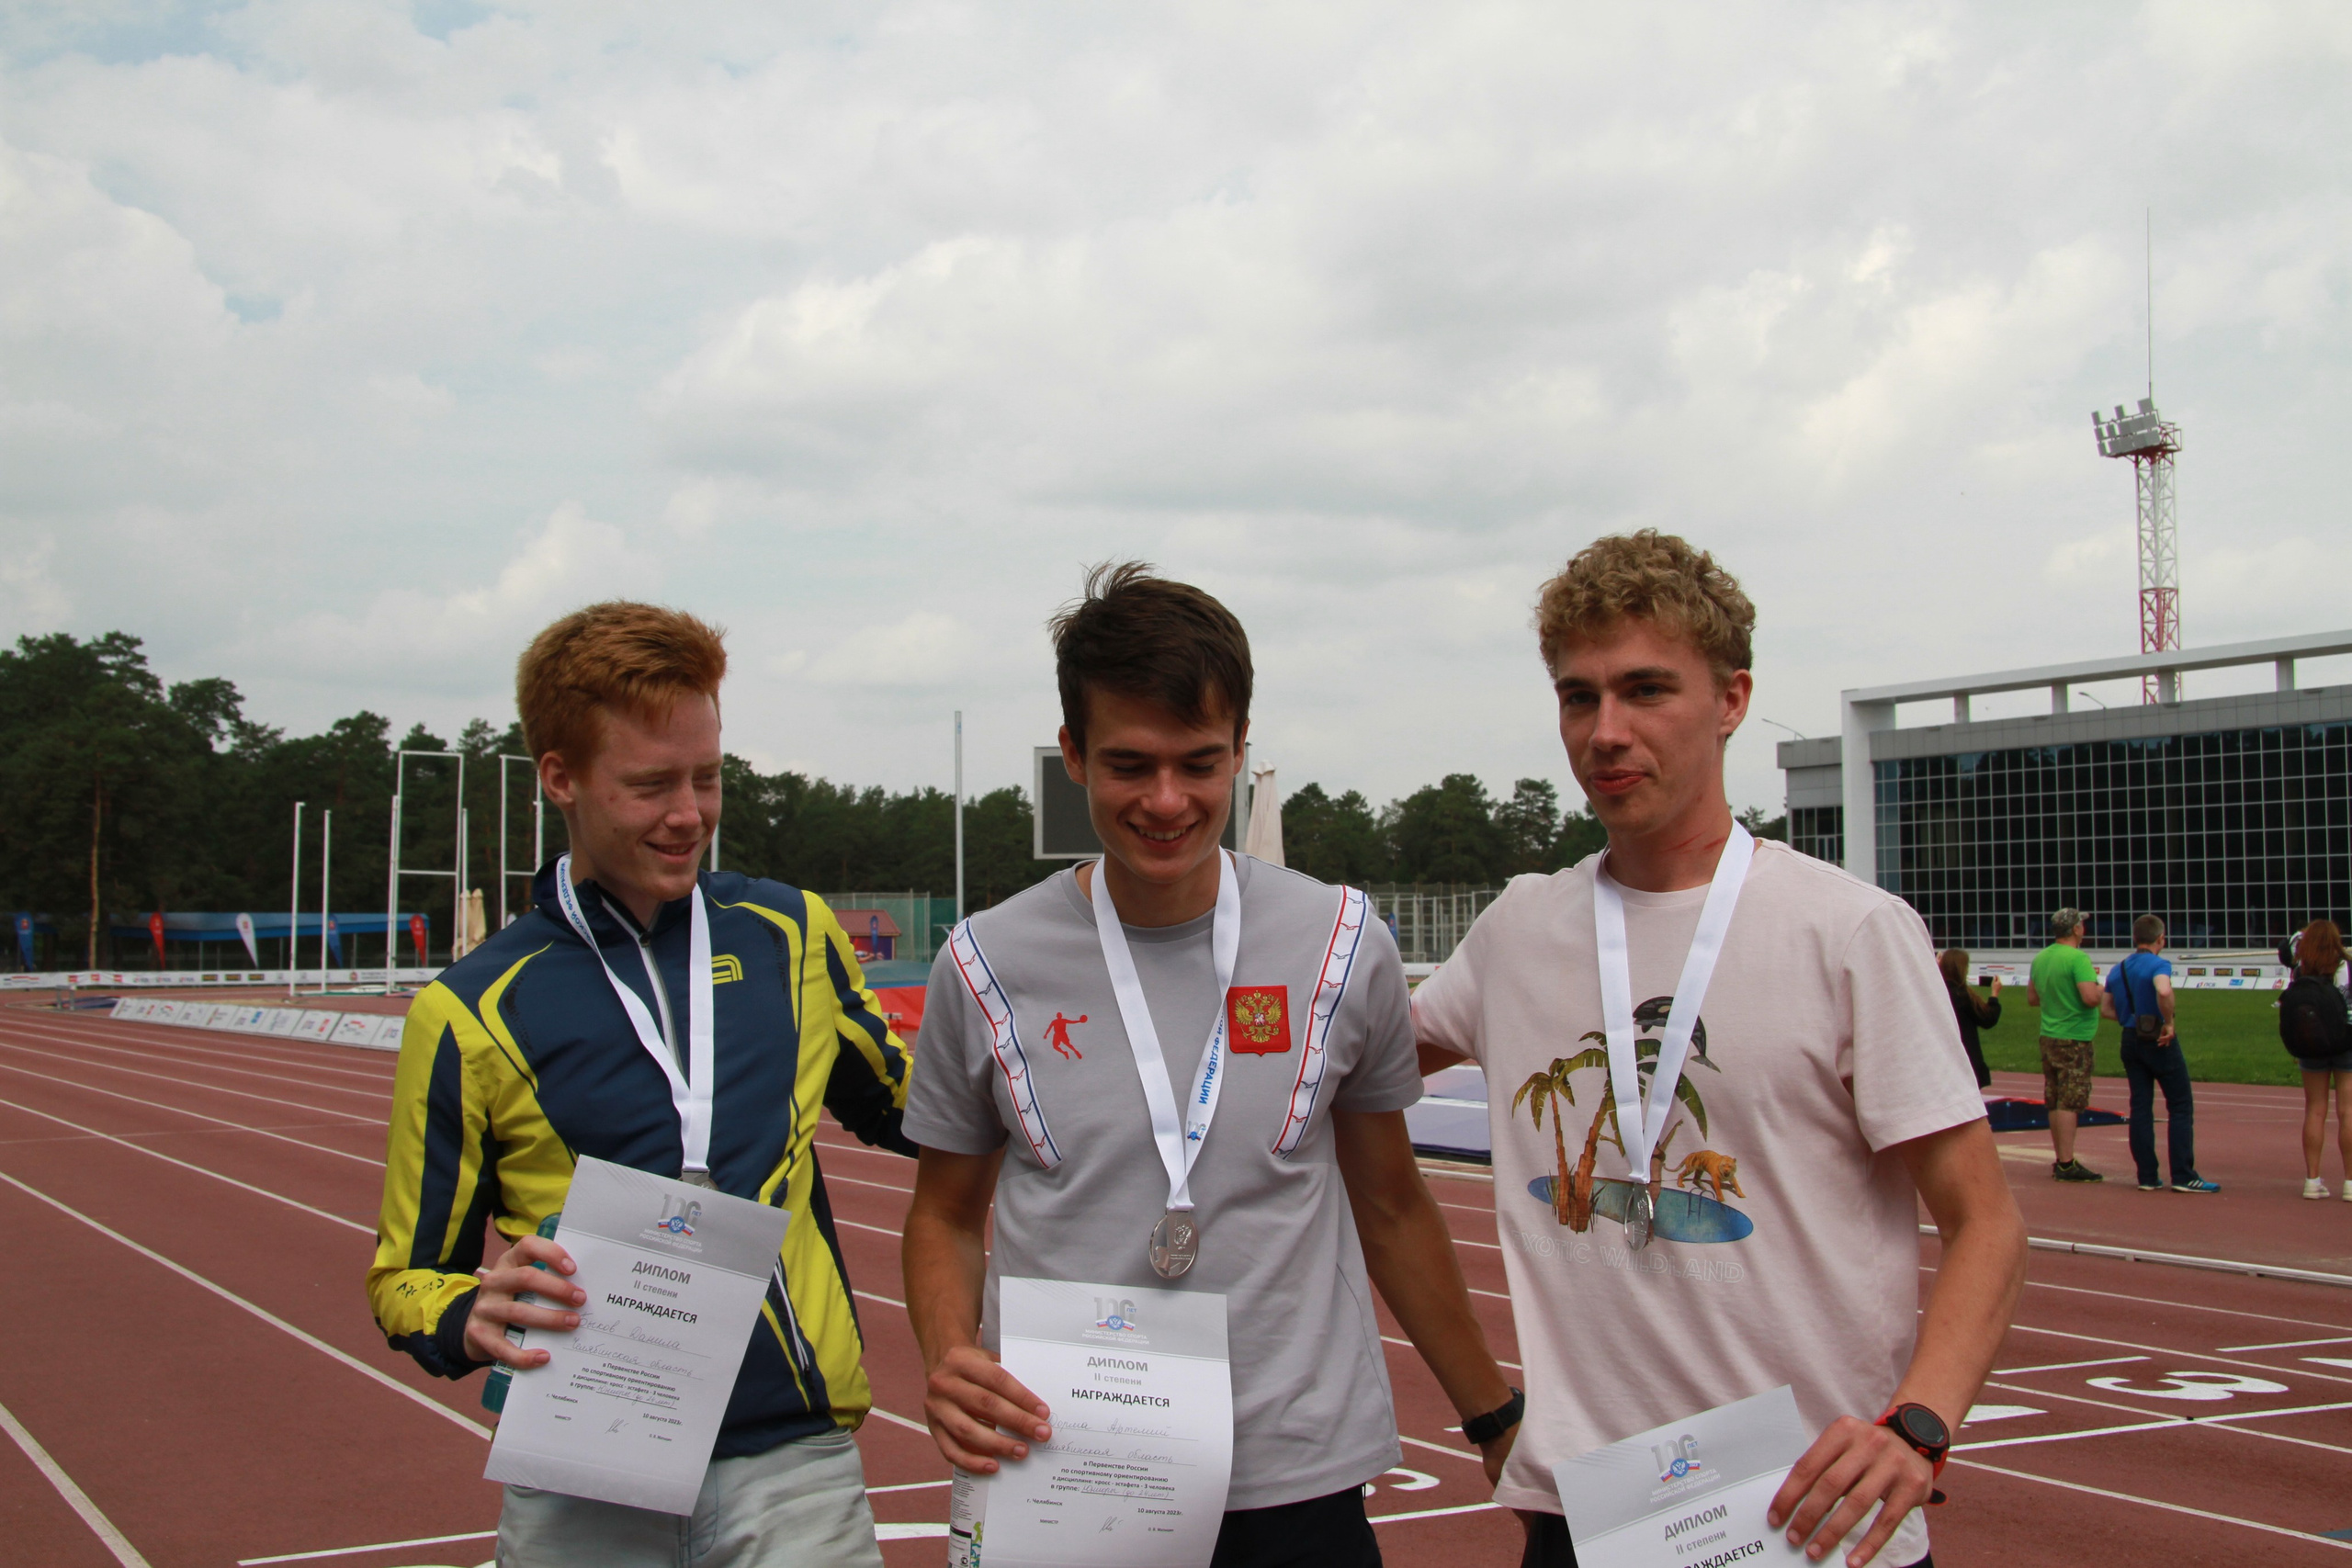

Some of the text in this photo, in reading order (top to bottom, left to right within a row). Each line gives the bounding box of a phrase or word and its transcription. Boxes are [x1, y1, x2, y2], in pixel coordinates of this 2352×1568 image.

[1198, 1036, 1220, 1105] ФЕДЕРАЦИИ
[631, 1260, 692, 1285] ДИПЛОМ
[642, 1283, 679, 1299] степени
[606, 1292, 698, 1324] НАГРАЖДАЕТСЯ
[606, 1362, 640, 1375] Первенстве
[640, 1370, 661, 1380] России
[1087, 1356, 1148, 1372] ДИПЛОМ
[590, 1369, 627, 1382] спортивному
[627, 1377, 676, 1393] ориентированию
[1103, 1374, 1142, 1386] степени
[2086, 1371, 2290, 1401] 3
[550, 1393, 579, 1404] Челябинск
[1071, 1388, 1170, 1408] НАГРАЖДАЕТСЯ
[649, 1415, 668, 1423] августа
[1088, 1461, 1125, 1471] Первенстве
[1057, 1476, 1094, 1484] дисциплине:
[1070, 1469, 1113, 1478] спортивному
[1114, 1473, 1169, 1483] ориентированию
[1056, 1484, 1080, 1493] группе:
[1032, 1498, 1063, 1506] Челябинск
[1664, 1504, 1728, 1541] ДИПЛОМ
[1686, 1529, 1727, 1551] степени
[1683, 1540, 1765, 1568] АЖДАЕТСЯ
